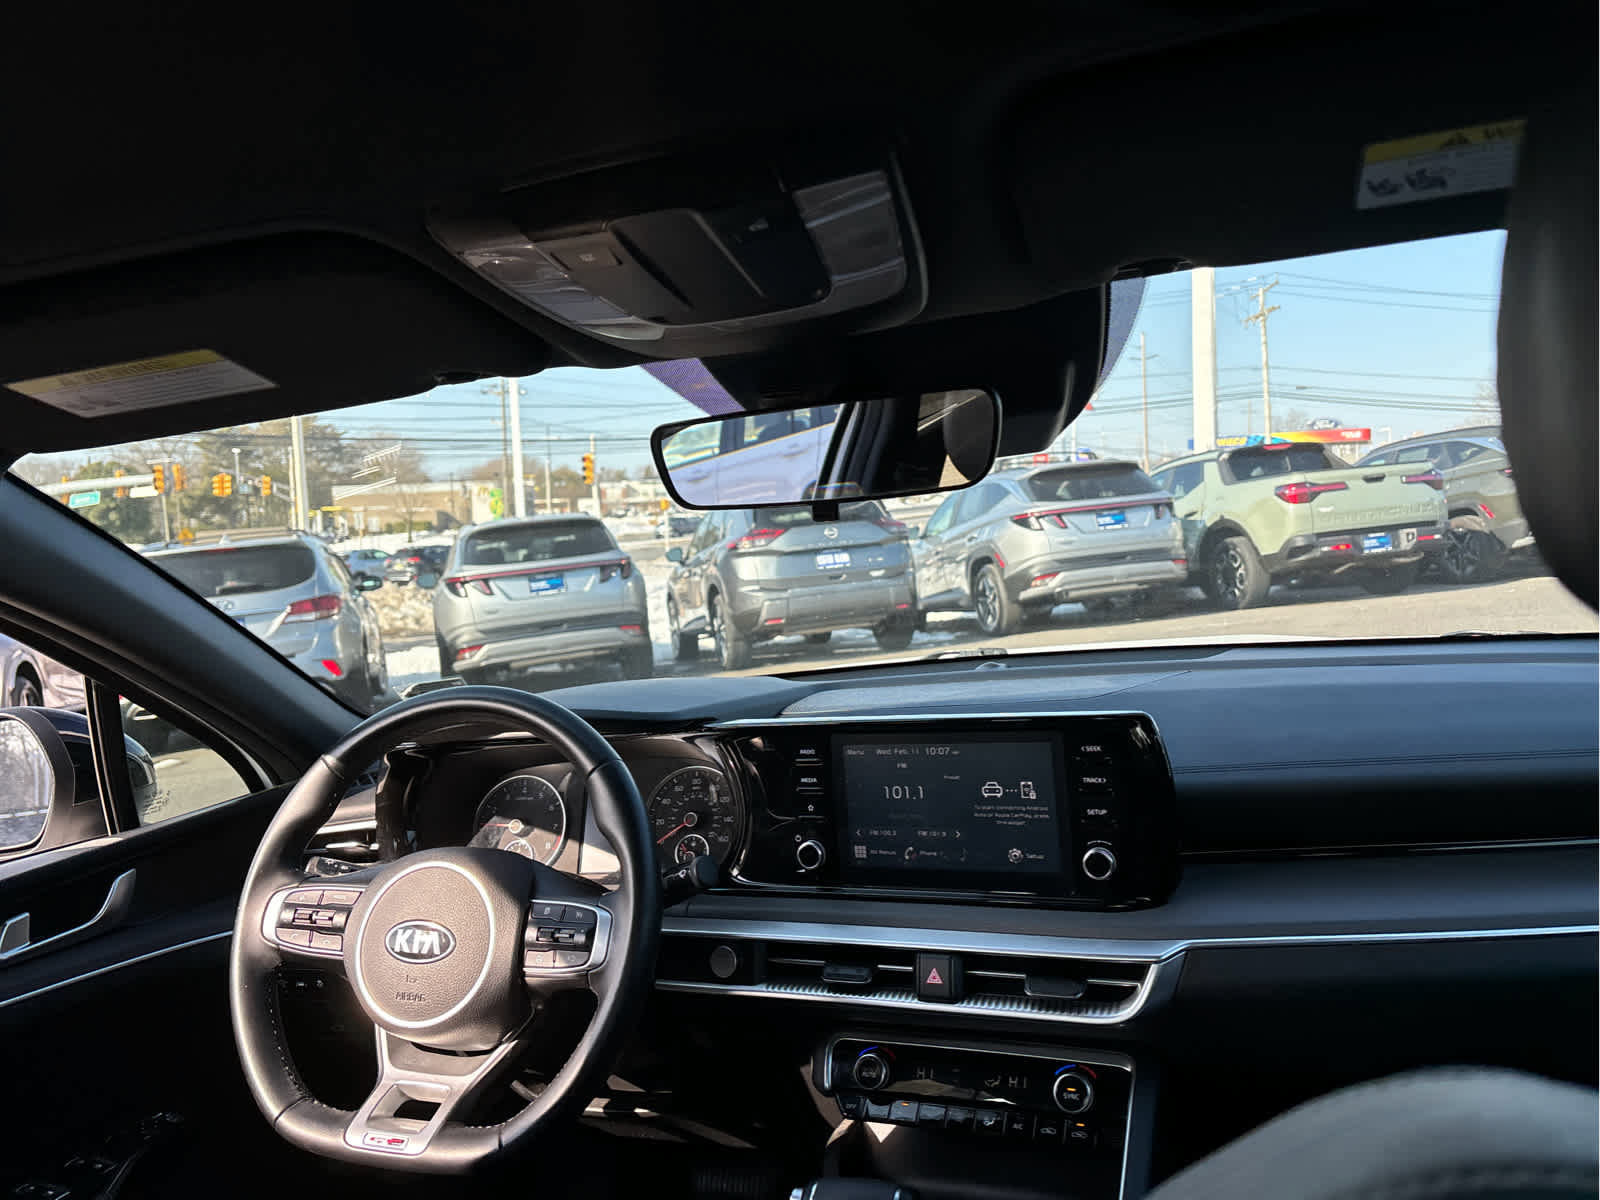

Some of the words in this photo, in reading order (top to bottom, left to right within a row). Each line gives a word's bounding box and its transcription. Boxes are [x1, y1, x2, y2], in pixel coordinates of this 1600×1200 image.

[925, 746, 951, 756] 10:07
[883, 784, 925, 800] 101.1
[655, 818, 665, 826] 20
[394, 928, 441, 955] KIA
[395, 991, 427, 1002] AIRBAG
[1008, 1075, 1028, 1089] HI
